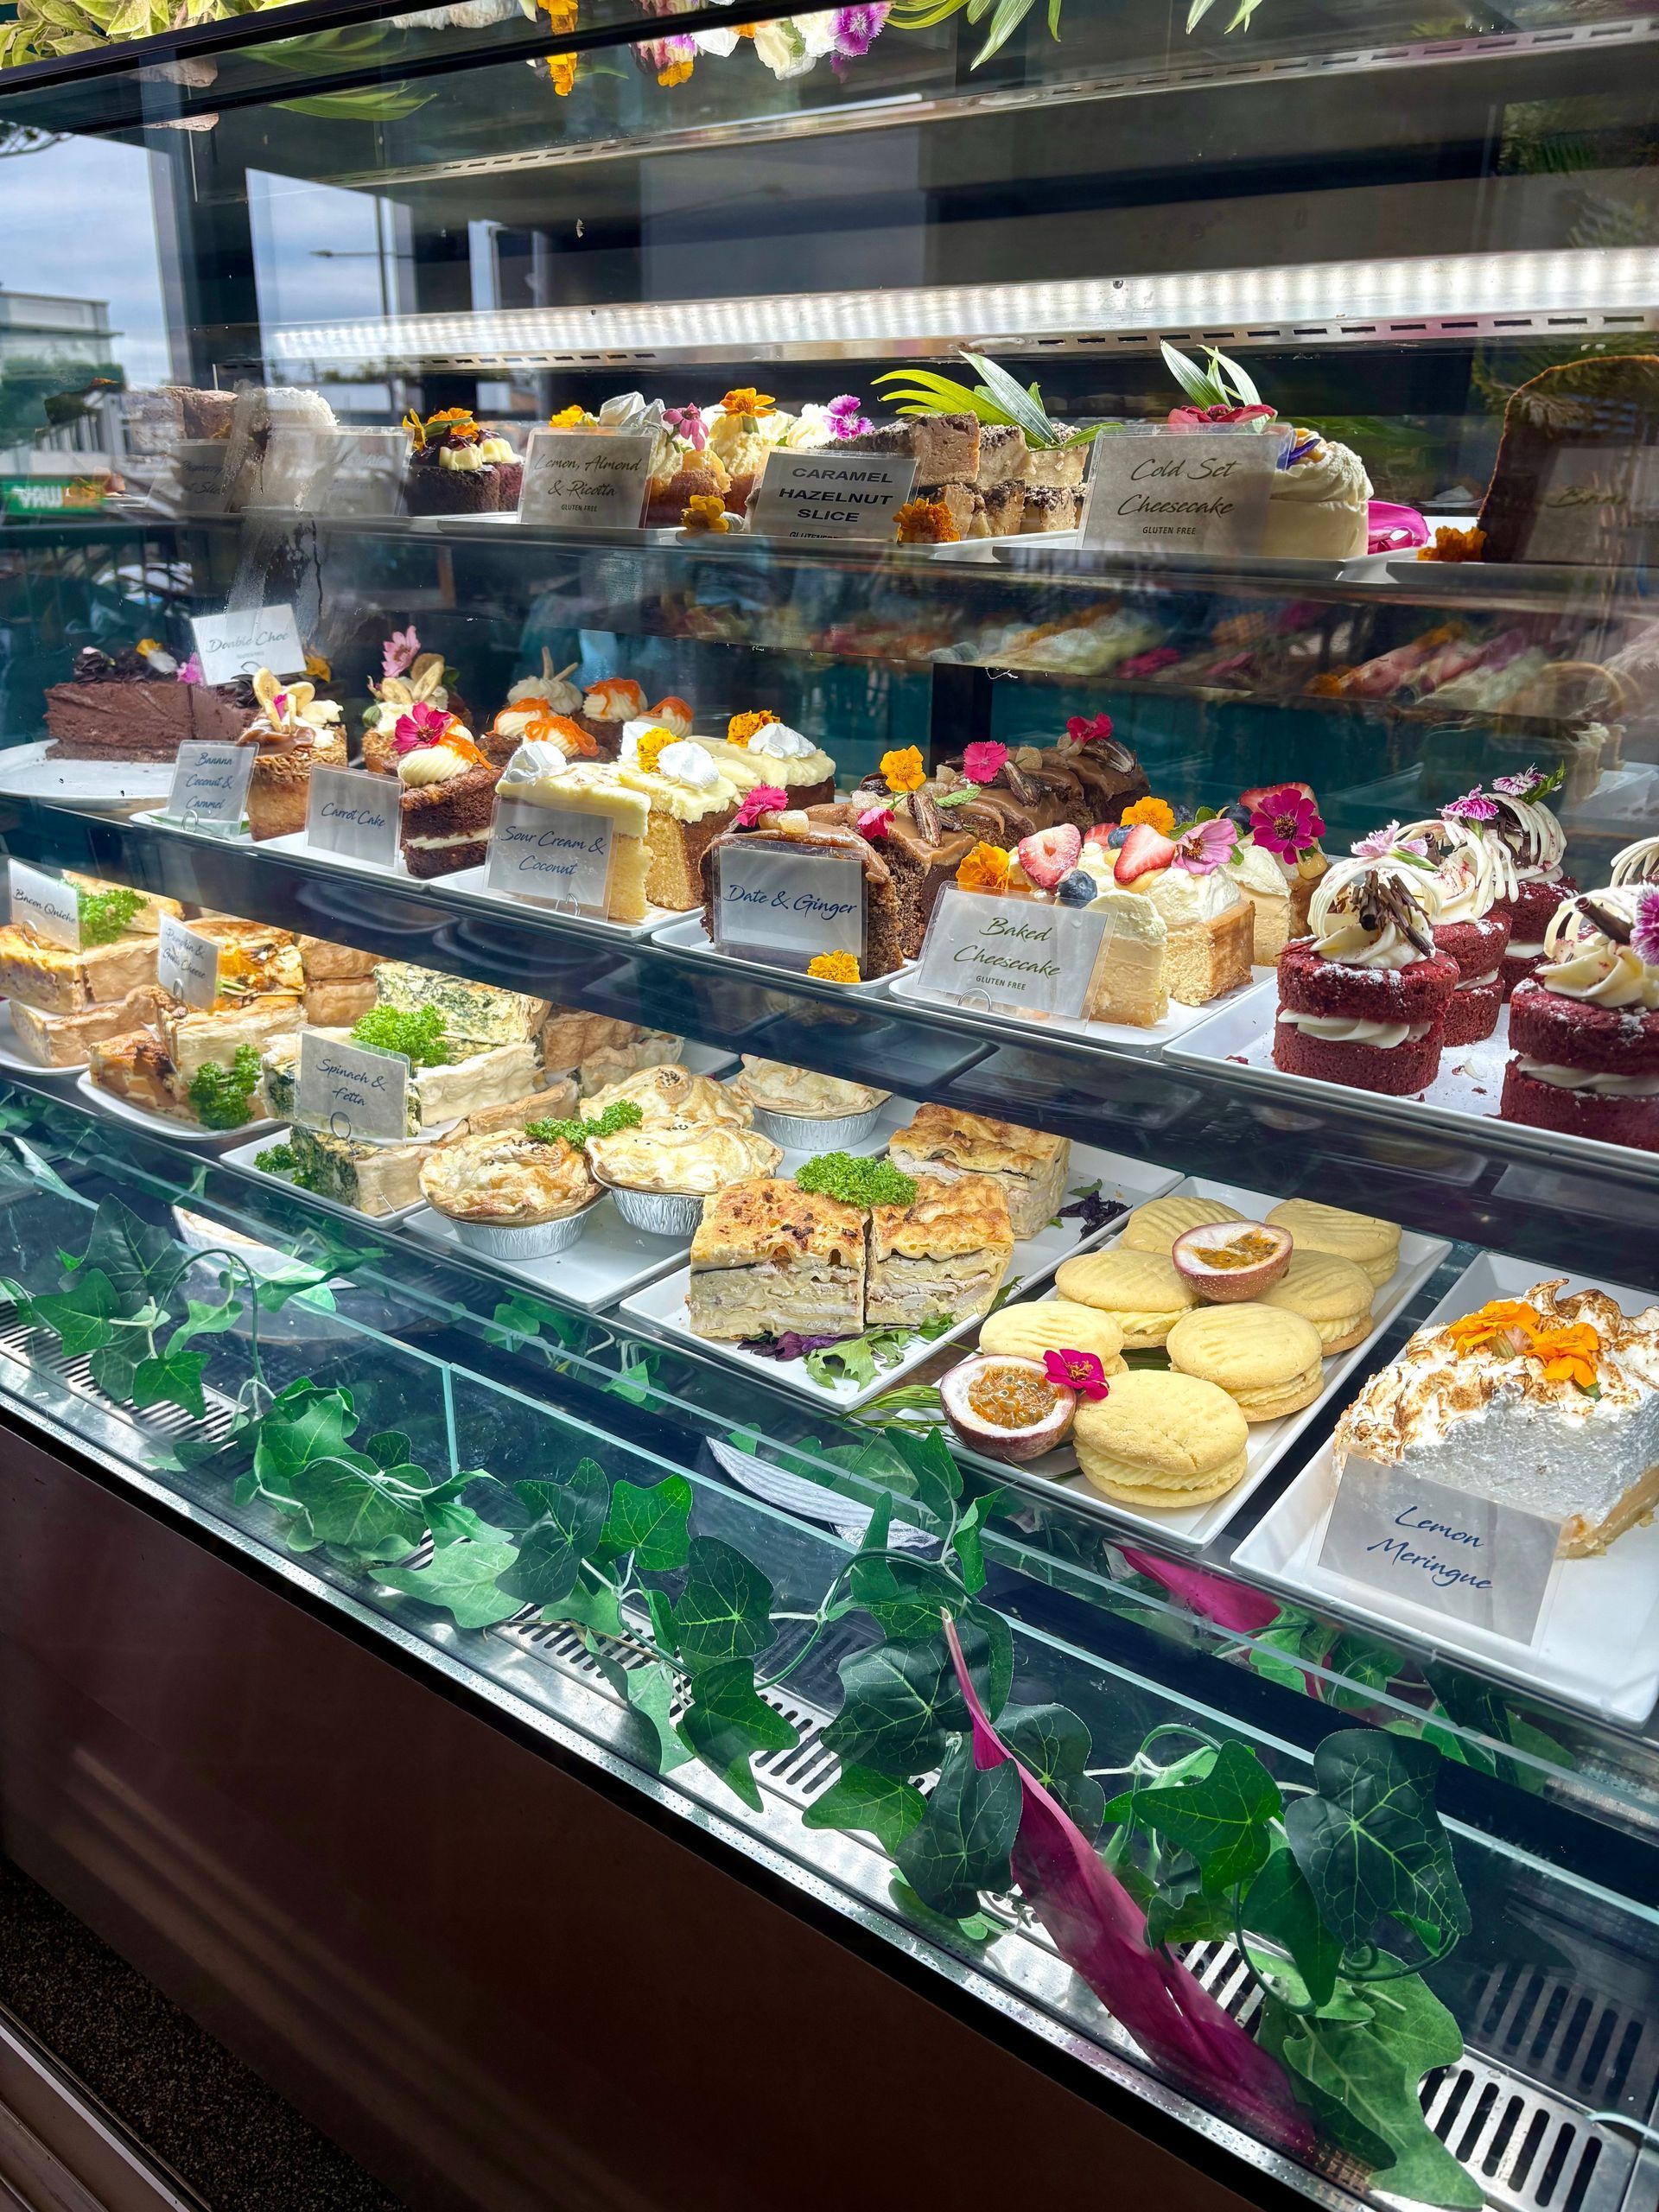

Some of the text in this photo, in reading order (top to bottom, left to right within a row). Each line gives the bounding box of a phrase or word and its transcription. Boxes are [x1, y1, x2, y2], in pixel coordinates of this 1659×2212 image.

[585, 454, 642, 472] Almond
[1131, 458, 1242, 480] Cold Set
[792, 467, 893, 483] CARAMEL
[548, 480, 616, 499] & Ricotta
[779, 487, 893, 505] HAZELNUT
[797, 508, 860, 522] SLICE
[1117, 493, 1236, 518] Cheesecake
[1142, 526, 1173, 535] GLUTEN
[206, 631, 289, 653] Double Choc
[194, 752, 232, 766] Banana
[186, 774, 234, 790] Coconut &
[186, 796, 226, 810] Caramel
[321, 802, 386, 827] Carrot Cake
[500, 825, 607, 855] Sour Cream &
[518, 855, 579, 875] Coconut
[13, 888, 42, 909] Bacon
[723, 884, 857, 920] Date & Ginger
[978, 917, 1053, 943] Baked
[194, 945, 206, 960] &
[953, 944, 1063, 979] Cheesecake
[976, 975, 1027, 991] GLUTEN FREE
[316, 1058, 388, 1091] Spinach &
[1394, 1505, 1484, 1548] Lemon
[1366, 1538, 1493, 1589] Meringue
